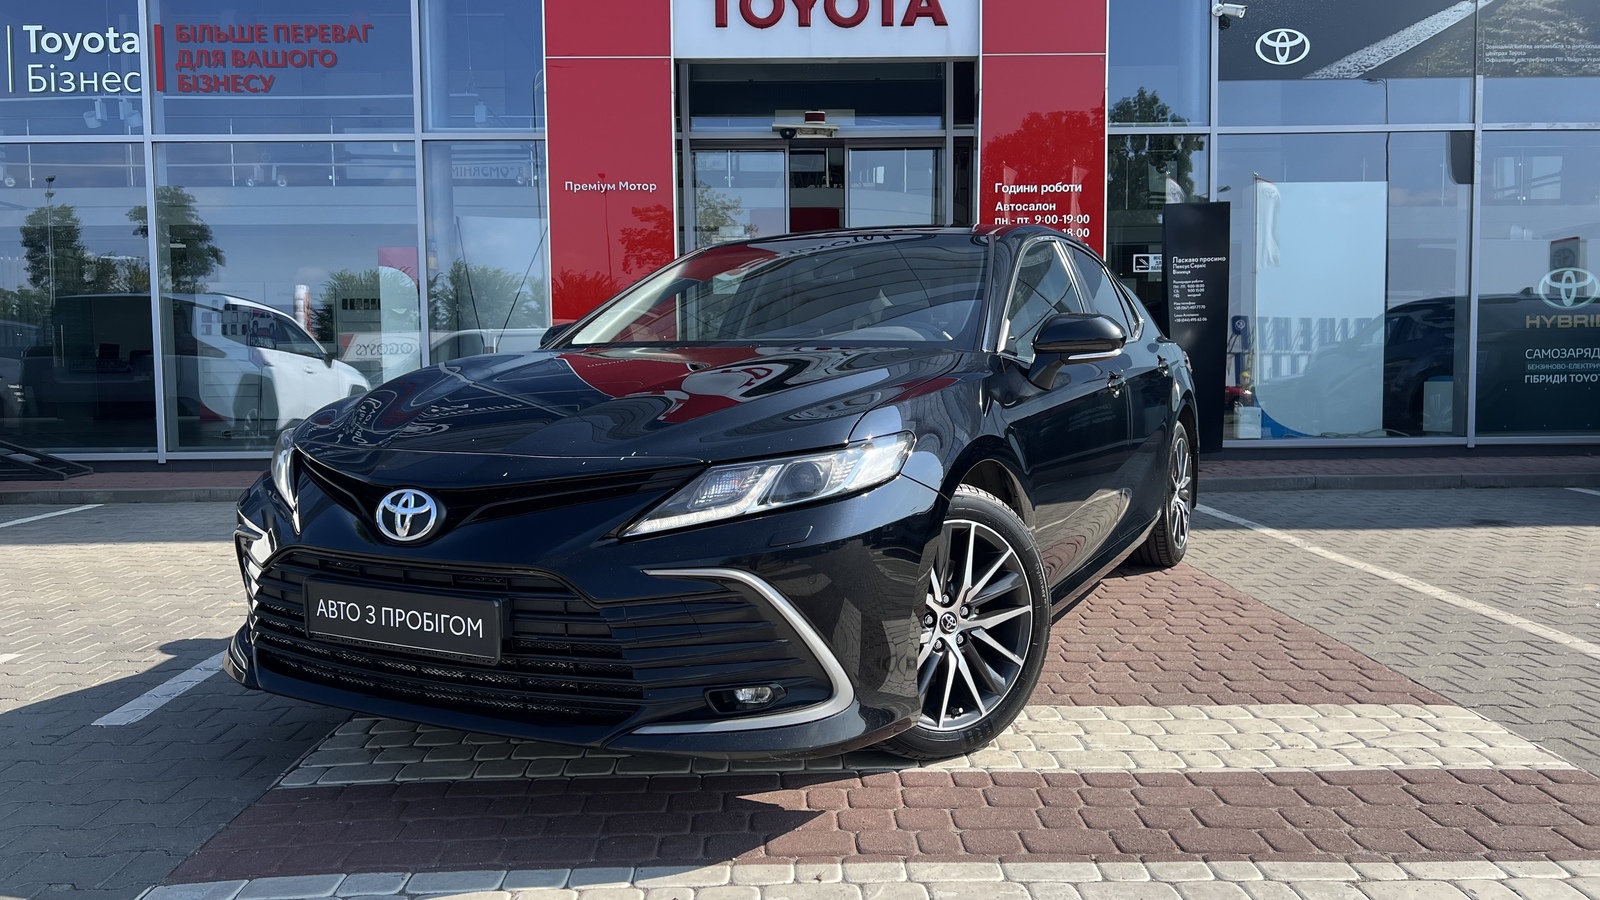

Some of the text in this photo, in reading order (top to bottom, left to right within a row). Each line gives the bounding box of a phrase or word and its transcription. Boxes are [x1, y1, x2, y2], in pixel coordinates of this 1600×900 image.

[174, 23, 374, 43] БІЛЬШЕ ПЕРЕВАГ
[22, 24, 140, 61] Toyota
[174, 49, 338, 71] ДЛЯ ВАШОГО
[27, 63, 142, 93] Бізнес
[177, 74, 275, 93] БІЗНЕСУ
[564, 180, 657, 193] Преміум Мотор
[994, 181, 1082, 195] Години роботи
[995, 201, 1056, 211] Автосалон
[1034, 214, 1090, 224] 9:00-19:00
[1525, 314, 1600, 329] HYBRI
[1525, 347, 1600, 360] САМОЗАРЯД
[1524, 373, 1567, 384] ГІБРИДИ
[316, 599, 361, 622] АВТО
[381, 607, 484, 639] ПРОБІГОМ
